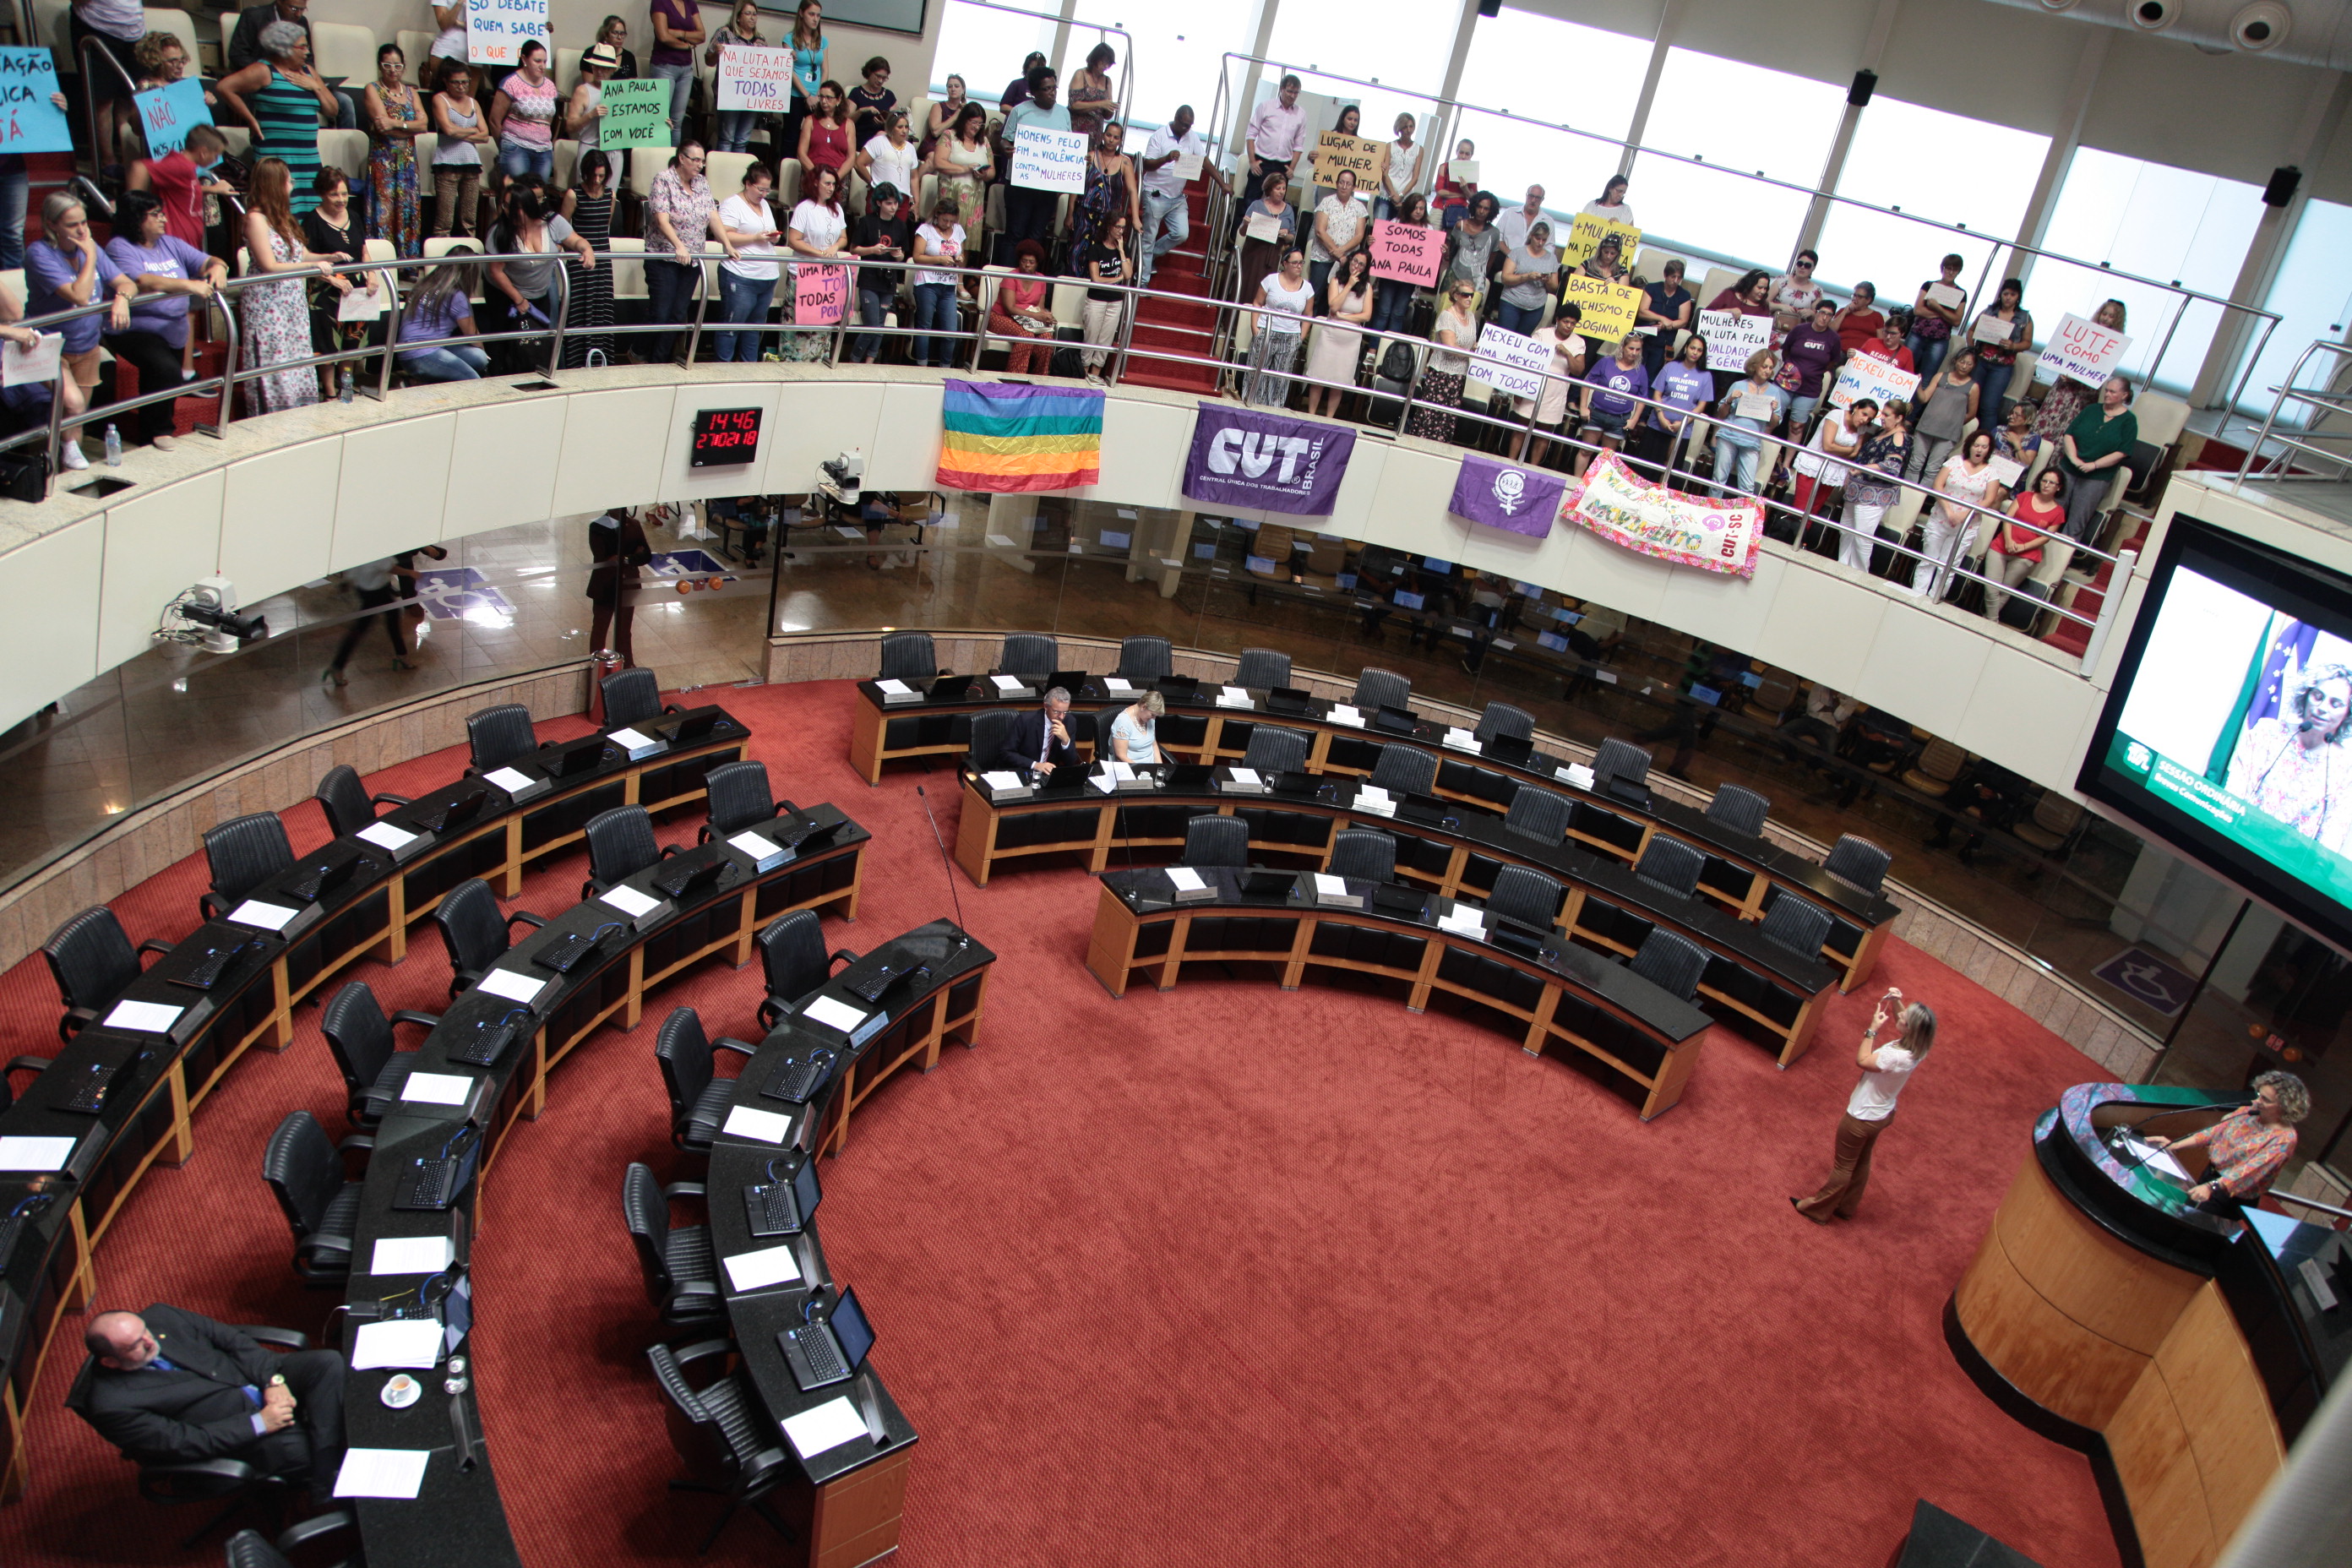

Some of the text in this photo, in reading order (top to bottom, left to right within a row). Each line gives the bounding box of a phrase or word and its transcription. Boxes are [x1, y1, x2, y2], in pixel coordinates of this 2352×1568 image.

[498, 0, 546, 14] DEBATE
[474, 18, 545, 36] QUEM SABE
[471, 46, 478, 57] O
[486, 46, 507, 59] QUE
[723, 51, 738, 64] NA
[743, 52, 769, 66] LUTA
[0, 53, 52, 77] AÇÃO
[725, 66, 790, 81] QUE SEJAMOS
[0, 85, 36, 106] ICA
[604, 81, 657, 99] ANA PAULA
[734, 80, 777, 98] TODAS
[612, 102, 662, 117] ESTAMOS
[746, 98, 784, 111] LIVRES
[146, 97, 177, 132] NÃO
[604, 122, 655, 144] COM VOCÊ
[1017, 129, 1081, 150] HOMENS PELO
[172, 138, 186, 153] CA
[1320, 134, 1377, 153] LUGAR DE
[1015, 145, 1030, 157] FIM
[1042, 148, 1085, 165] VIOLÊNCIA
[1327, 155, 1372, 171] MULHER
[1015, 161, 1083, 182] CONTRA MULHERES
[1020, 172, 1029, 181] AS
[1312, 168, 1320, 182] É
[1322, 174, 1333, 183] NA
[1385, 225, 1426, 242] SOMOS
[1386, 241, 1424, 257] TODAS
[1568, 242, 1579, 253] NA
[799, 266, 819, 278] UMA
[1369, 258, 1431, 278] ANA PAULA
[1570, 280, 1632, 299] BASTA DE
[799, 292, 836, 308] TODAS
[821, 305, 839, 319] POR
[1625, 310, 1635, 320] E
[1574, 319, 1620, 336] SOGINIA
[1701, 314, 1754, 329] MULHERES
[1482, 328, 1550, 358] MEXEU COM
[1700, 329, 1765, 345] NA LUTA PELA
[2062, 320, 2119, 356] LUTE
[1707, 342, 1750, 358] UALDADE
[1870, 351, 1899, 366] RESISIR
[2064, 343, 2100, 364] COMO
[1707, 355, 1744, 369] E GÊNE
[2042, 351, 2107, 383] UMA MULHER
[1467, 365, 1538, 395] COM TODAS
[1669, 376, 1699, 387] MULHERES
[1839, 373, 1860, 389] UMA
[1847, 356, 1886, 378] MEXEU
[1888, 373, 1914, 390] COM
[1670, 391, 1690, 401] LUTAM
[1832, 391, 1853, 406] COM
[1207, 427, 1309, 484] CUT
[1302, 437, 1324, 490] BRASIL
[1200, 475, 1226, 483] CENTRAL
[1227, 477, 1245, 487] ÚNICA
[1260, 484, 1310, 496] TRABALHADORES
[1585, 498, 1702, 551] MOVIMENTO
[2159, 760, 2246, 816] SESSÃO ORDINÁRIA
[2154, 772, 2233, 824] Breves Comunicações
